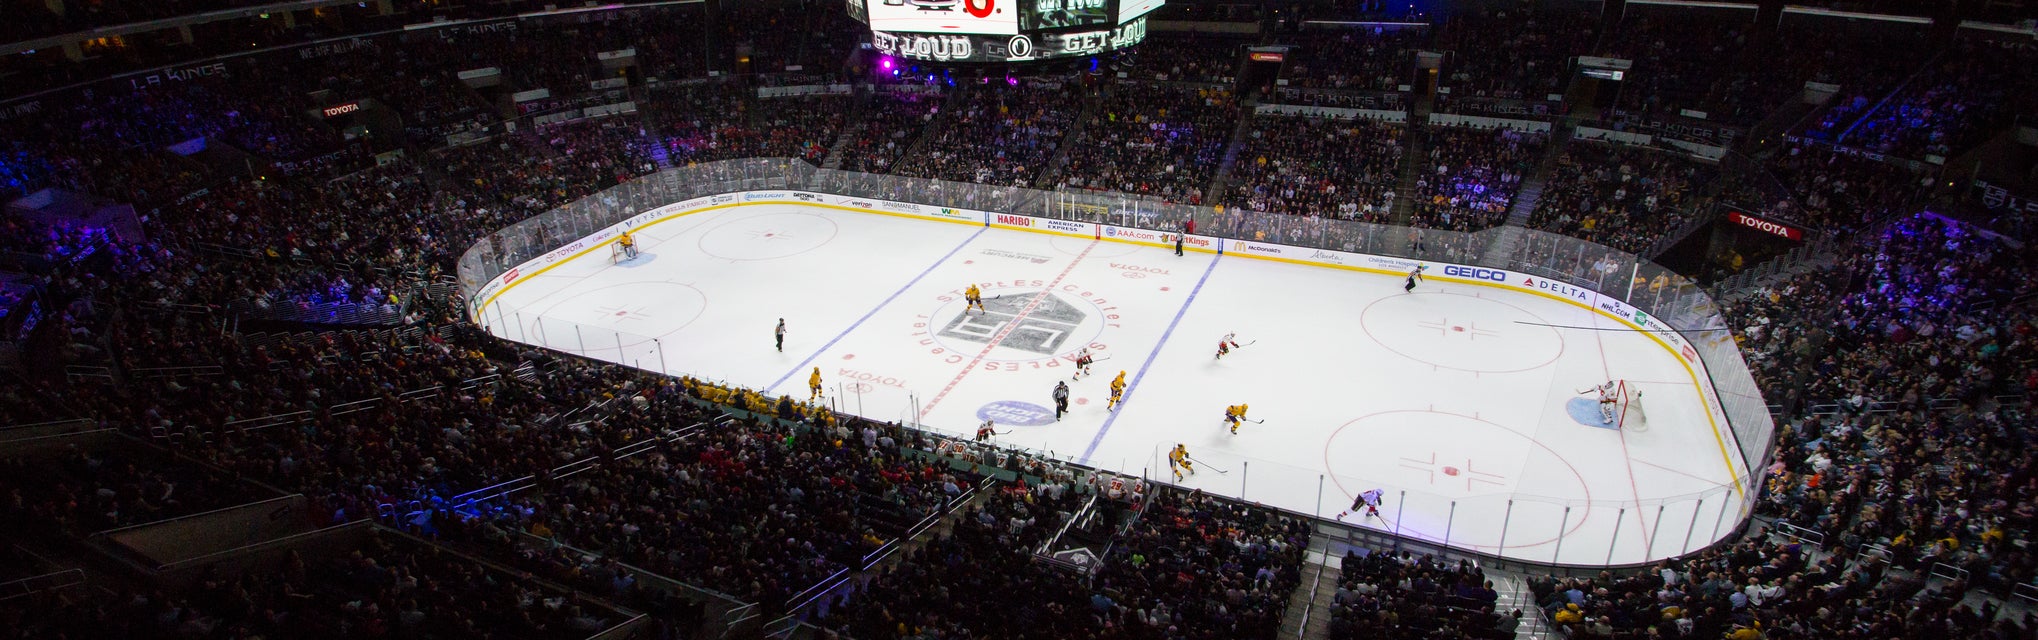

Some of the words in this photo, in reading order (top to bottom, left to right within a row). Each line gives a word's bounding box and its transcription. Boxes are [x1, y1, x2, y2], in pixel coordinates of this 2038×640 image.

[873, 31, 899, 50] GET
[903, 35, 972, 60] LOUD
[1064, 30, 1110, 52] GET
[131, 74, 161, 90] LA
[167, 63, 226, 83] KINGS
[324, 103, 360, 117] TOYOTA
[665, 205, 686, 214] WELLS
[686, 200, 708, 209] FARGO
[852, 201, 873, 209] verizon
[997, 214, 1030, 228] HARIBO
[1047, 220, 1085, 230] AMERICAN
[1739, 214, 1789, 239] TOYOTA
[1047, 224, 1078, 233] EXPRESS
[1117, 229, 1155, 242] AAA.com
[556, 242, 584, 258] TOYOTA
[1247, 244, 1281, 255] McDonald's
[1368, 256, 1395, 265] Children's
[1109, 262, 1171, 276] TOYOTA
[1444, 265, 1506, 282] GEICO
[937, 279, 1044, 302] STPLES
[1539, 280, 1587, 300] DELTA
[1601, 302, 1631, 319] NHL.COM
[838, 368, 907, 388] TOYOTA
[1110, 481, 1123, 491] 29
